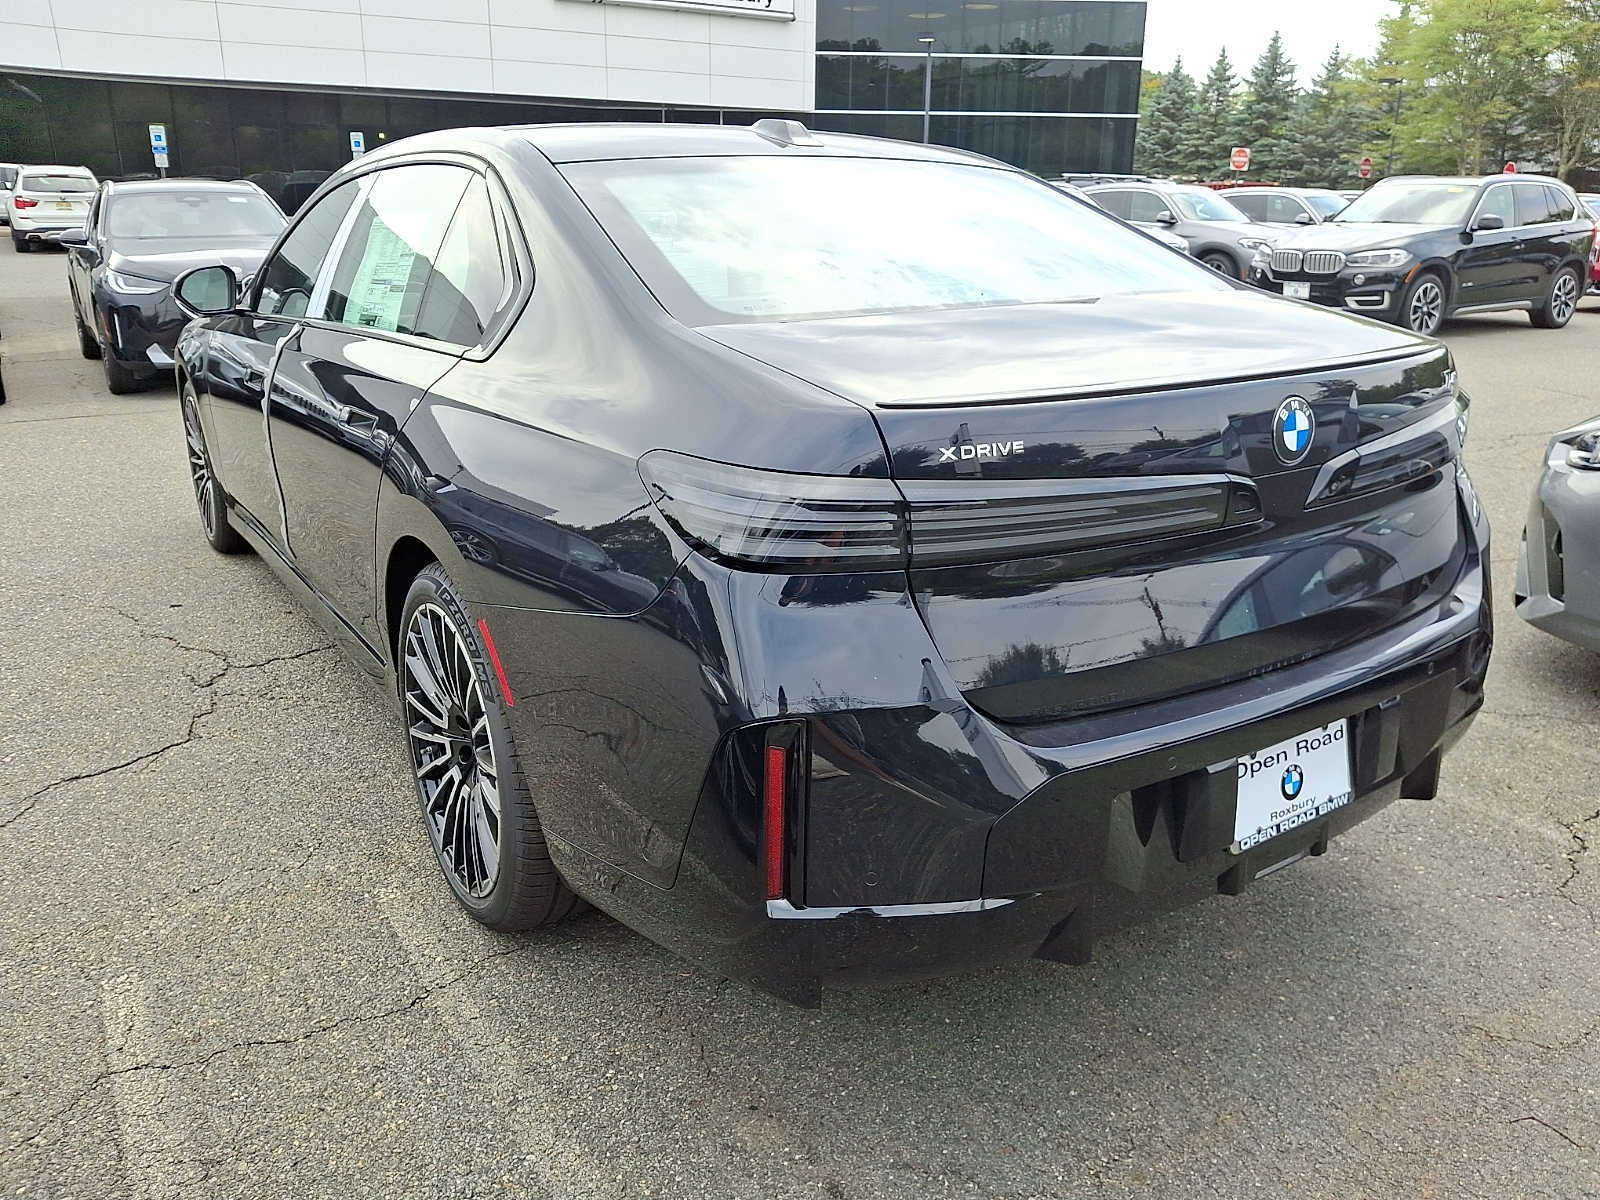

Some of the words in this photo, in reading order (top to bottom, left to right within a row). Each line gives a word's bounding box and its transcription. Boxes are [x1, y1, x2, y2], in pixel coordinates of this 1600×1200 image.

[1280, 401, 1311, 421] BMW
[1238, 750, 1288, 779] Open
[1296, 724, 1344, 756] Road
[1240, 825, 1278, 851] OPEN
[1280, 807, 1317, 833] ROAD
[1318, 793, 1350, 815] BMW
[1270, 796, 1317, 822] Roxbury
